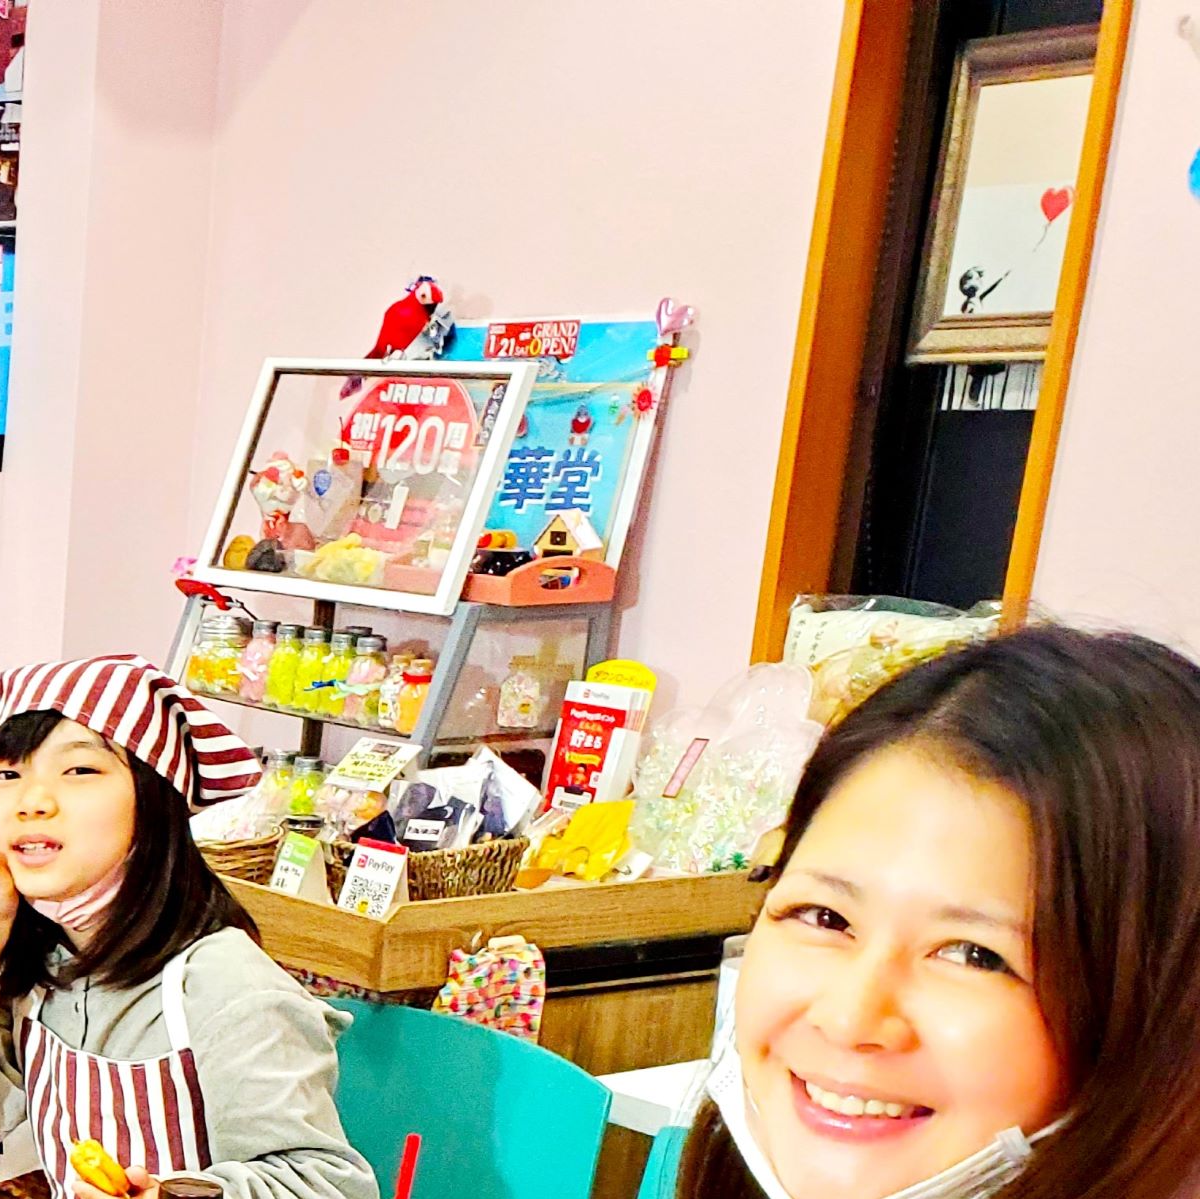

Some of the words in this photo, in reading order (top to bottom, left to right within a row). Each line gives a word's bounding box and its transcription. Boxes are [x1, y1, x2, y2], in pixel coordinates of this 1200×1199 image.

[532, 322, 579, 338] GRAND
[529, 337, 576, 356] OPEN!
[376, 414, 446, 475] 120
[499, 445, 601, 515] 華堂
[367, 857, 396, 874] PayPay
